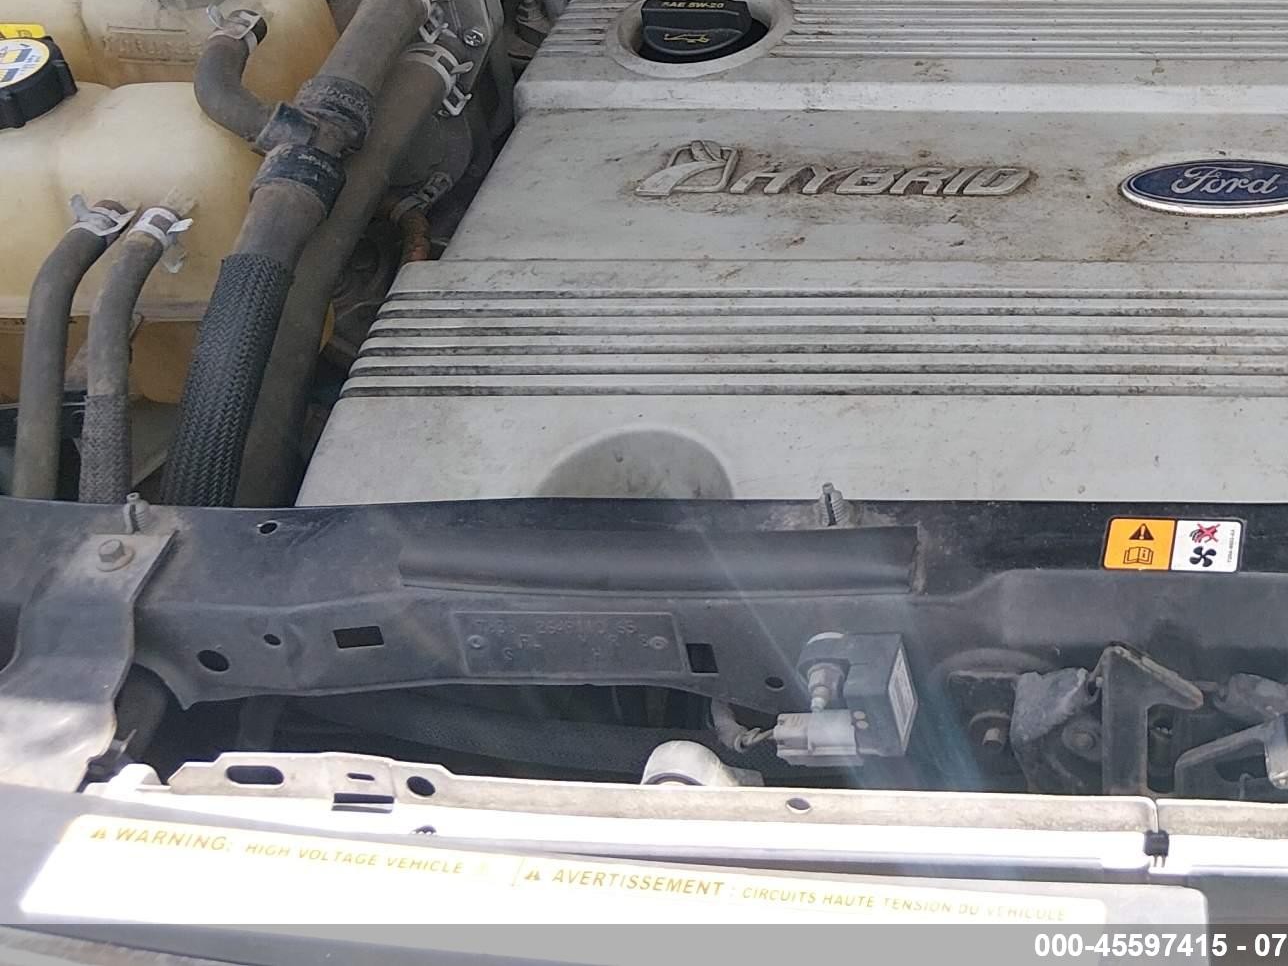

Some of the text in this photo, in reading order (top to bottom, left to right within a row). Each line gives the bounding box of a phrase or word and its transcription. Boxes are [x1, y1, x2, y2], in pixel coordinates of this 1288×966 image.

[730, 165, 1280, 196] HYBRID Ford
[115, 827, 465, 874] WARNING: HIGH VOLTAGE VEHICLE
[552, 868, 725, 896] AVERTISSEMENT
[742, 887, 817, 904] CIRCUITS
[822, 891, 875, 908] HAUTE
[883, 896, 951, 913] TENSION
